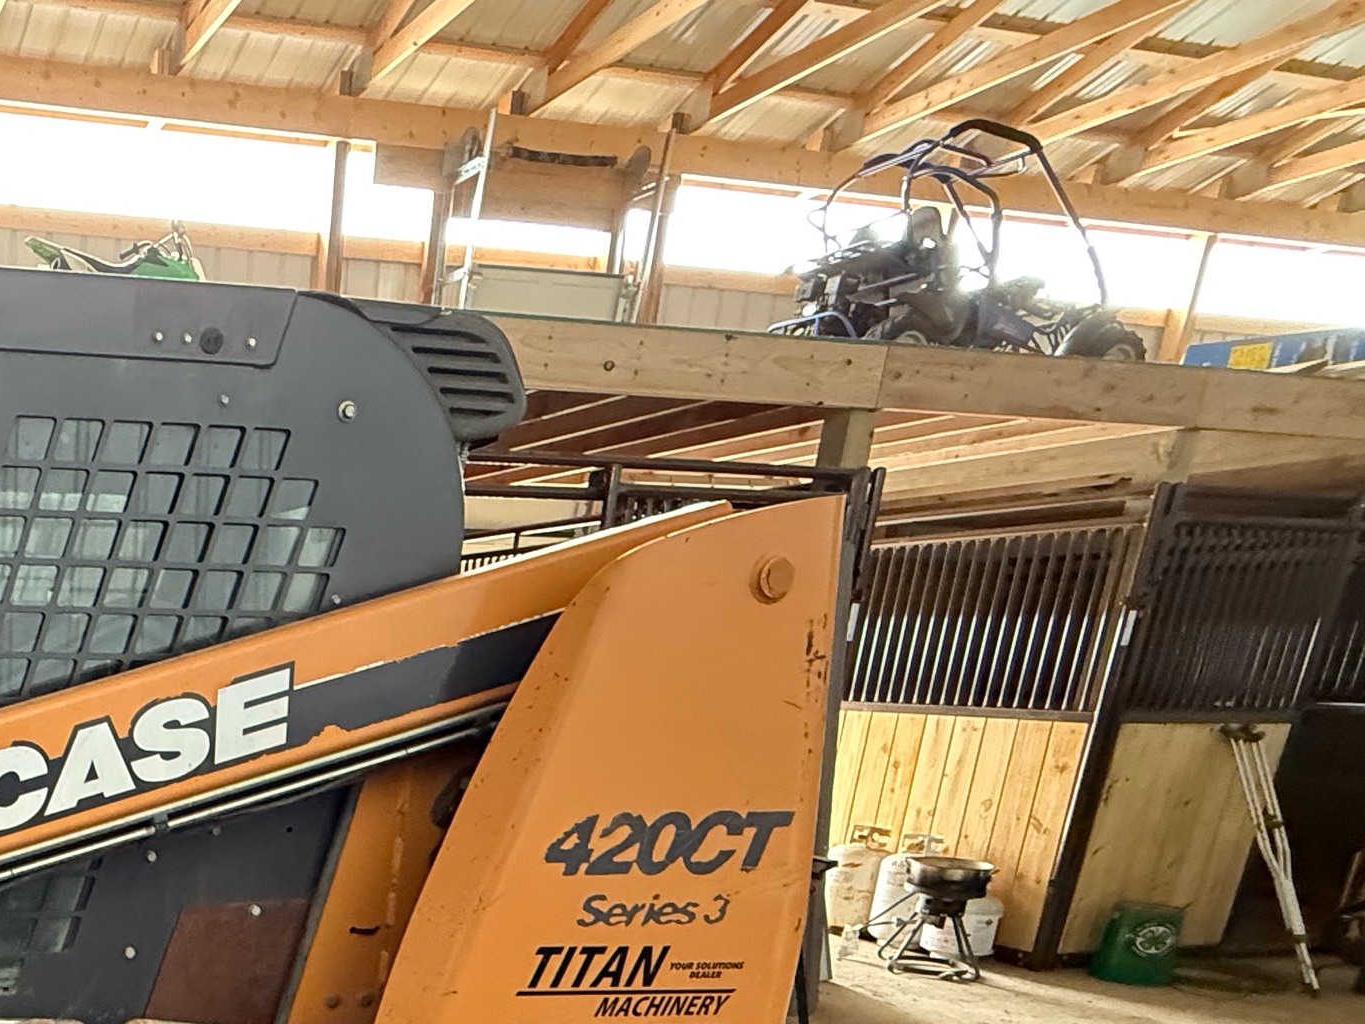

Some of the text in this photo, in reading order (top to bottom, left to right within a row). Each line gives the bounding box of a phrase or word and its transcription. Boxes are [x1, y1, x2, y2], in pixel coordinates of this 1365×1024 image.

[544, 809, 795, 876] 420CT
[576, 894, 731, 928] Series 3
[527, 945, 671, 989] TITAN
[670, 961, 745, 970] YOUR SOLUTIONS
[689, 971, 722, 979] DEALER
[594, 995, 731, 1017] MACHINERY
